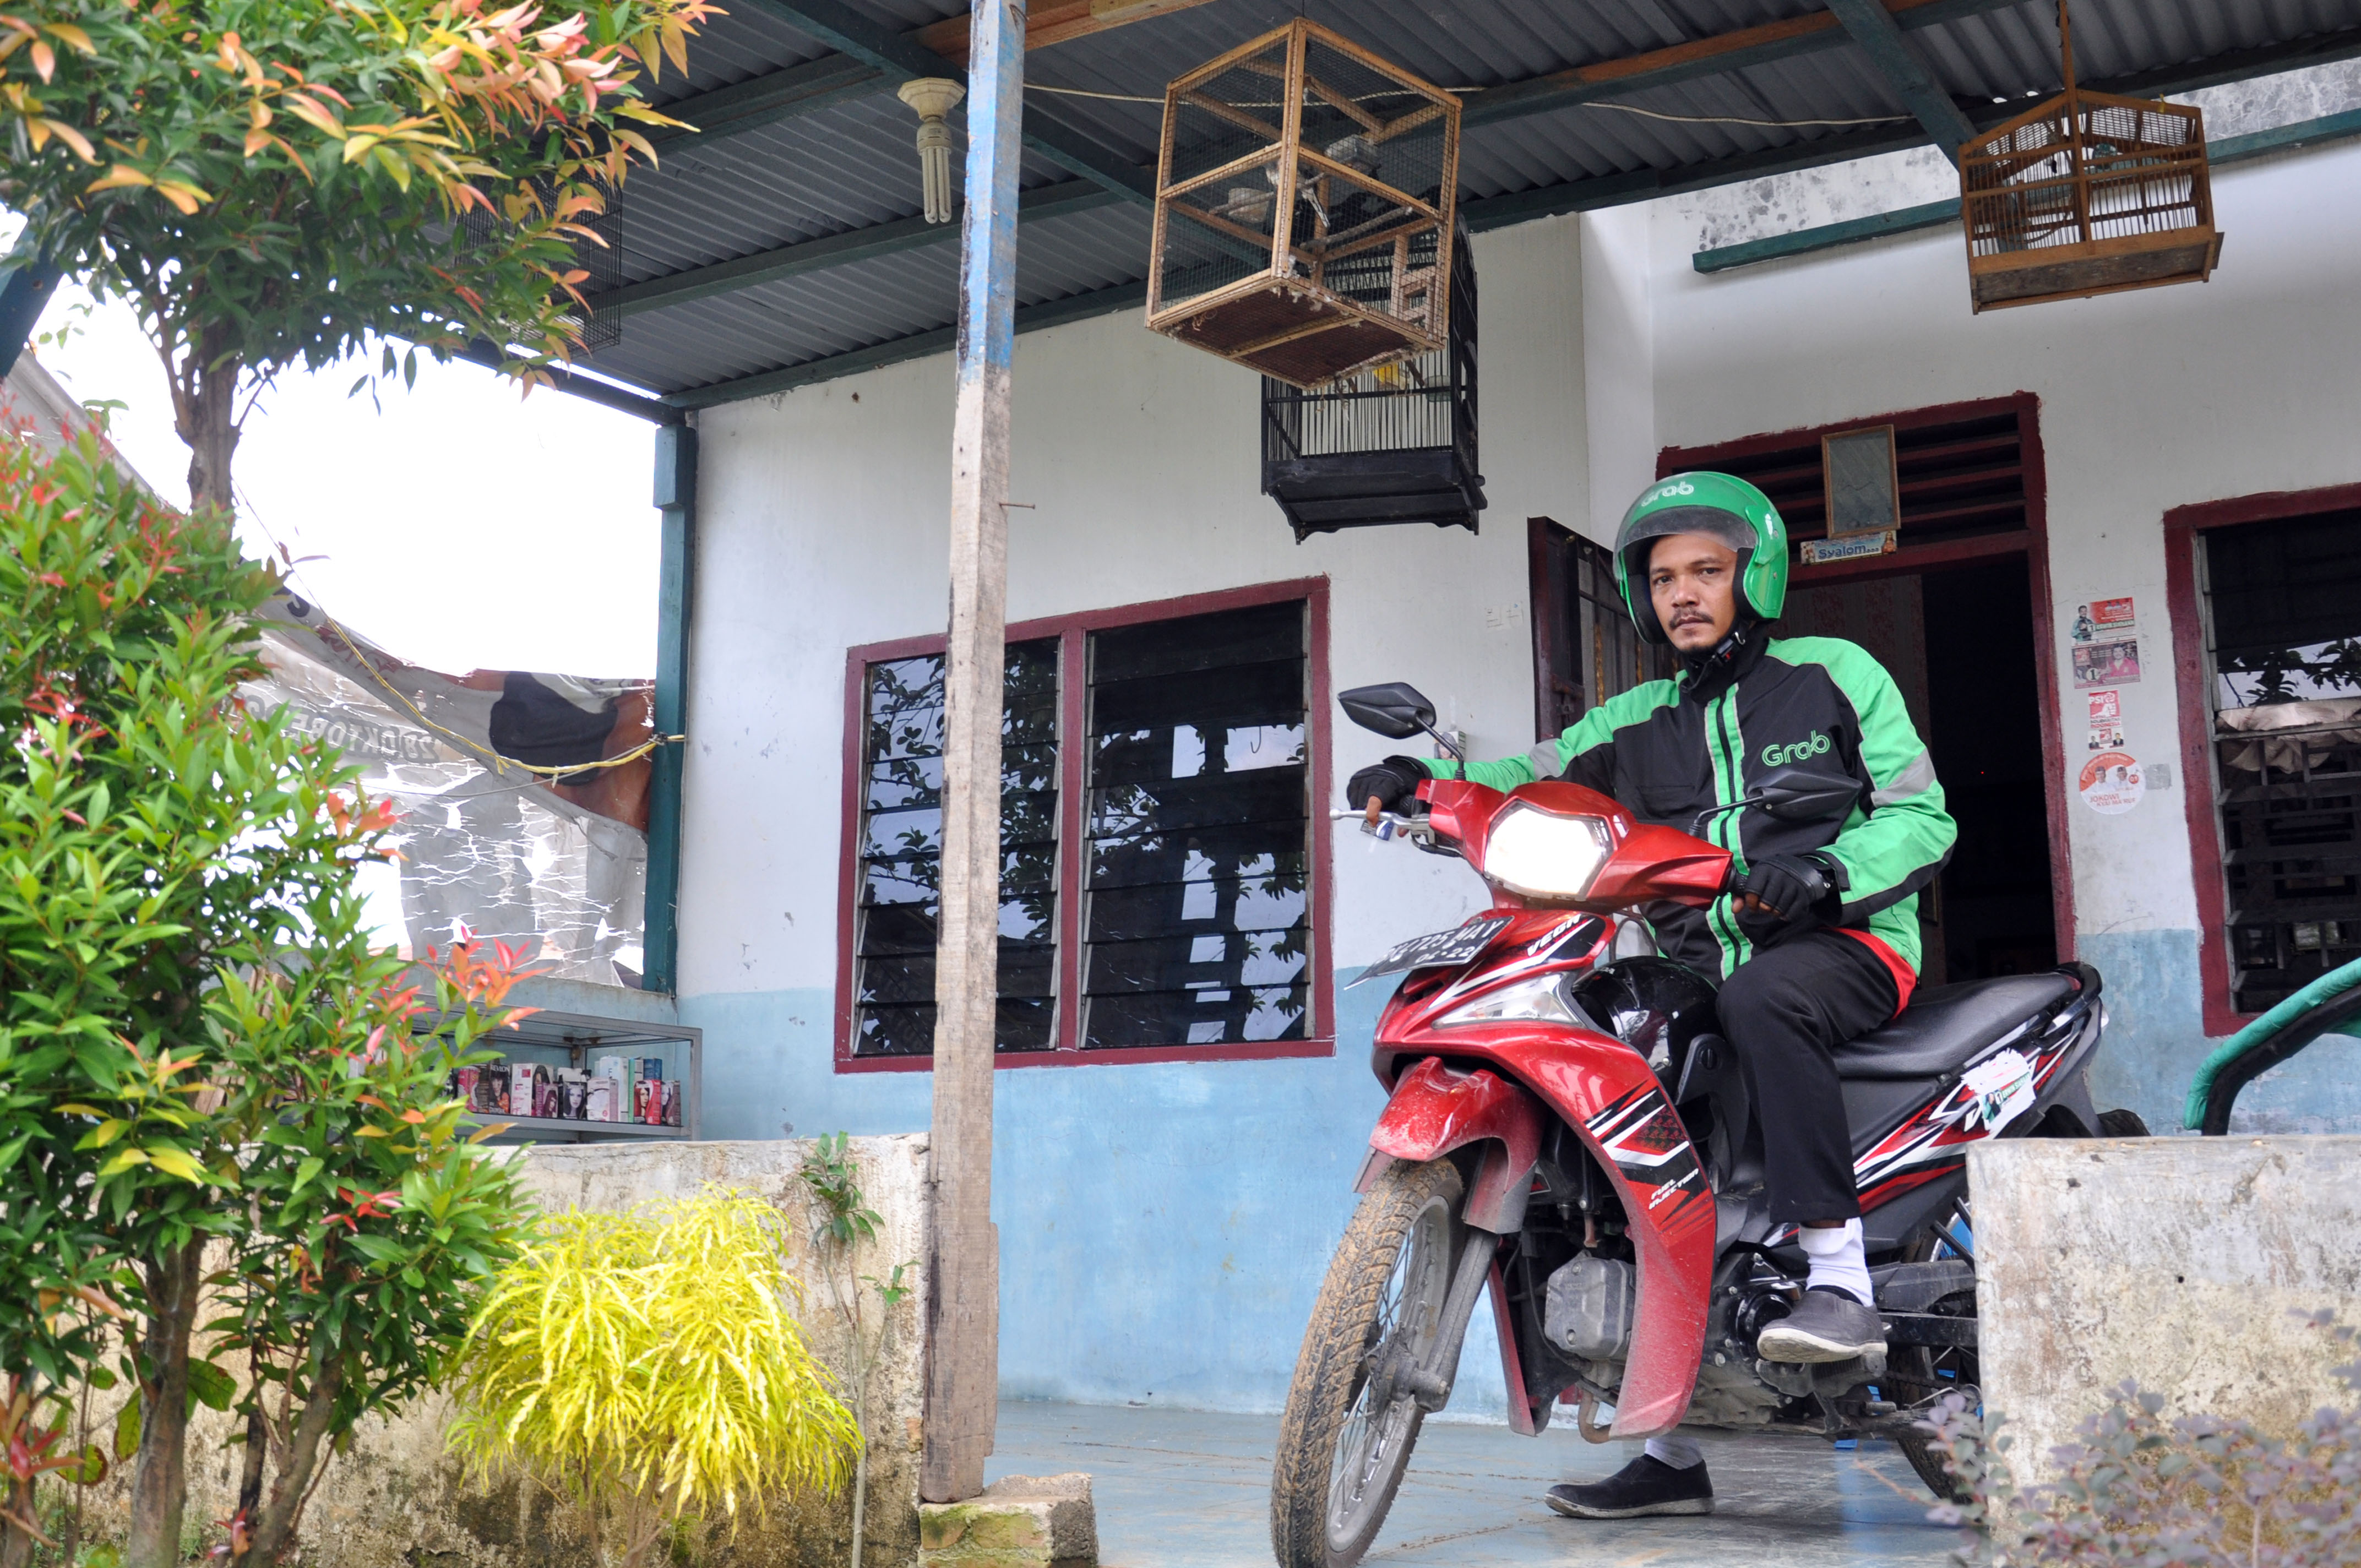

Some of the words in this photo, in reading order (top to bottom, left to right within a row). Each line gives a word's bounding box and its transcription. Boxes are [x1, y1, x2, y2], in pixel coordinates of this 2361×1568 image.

[1641, 481, 1694, 507] Grab
[2090, 668, 2097, 680] 1
[2088, 695, 2104, 705] PSI
[1761, 729, 1831, 767] Grab
[2090, 793, 2120, 803] JOKOWI
[1649, 1168, 1699, 1210] INJECTION
[1651, 1179, 1675, 1200] FUEL
